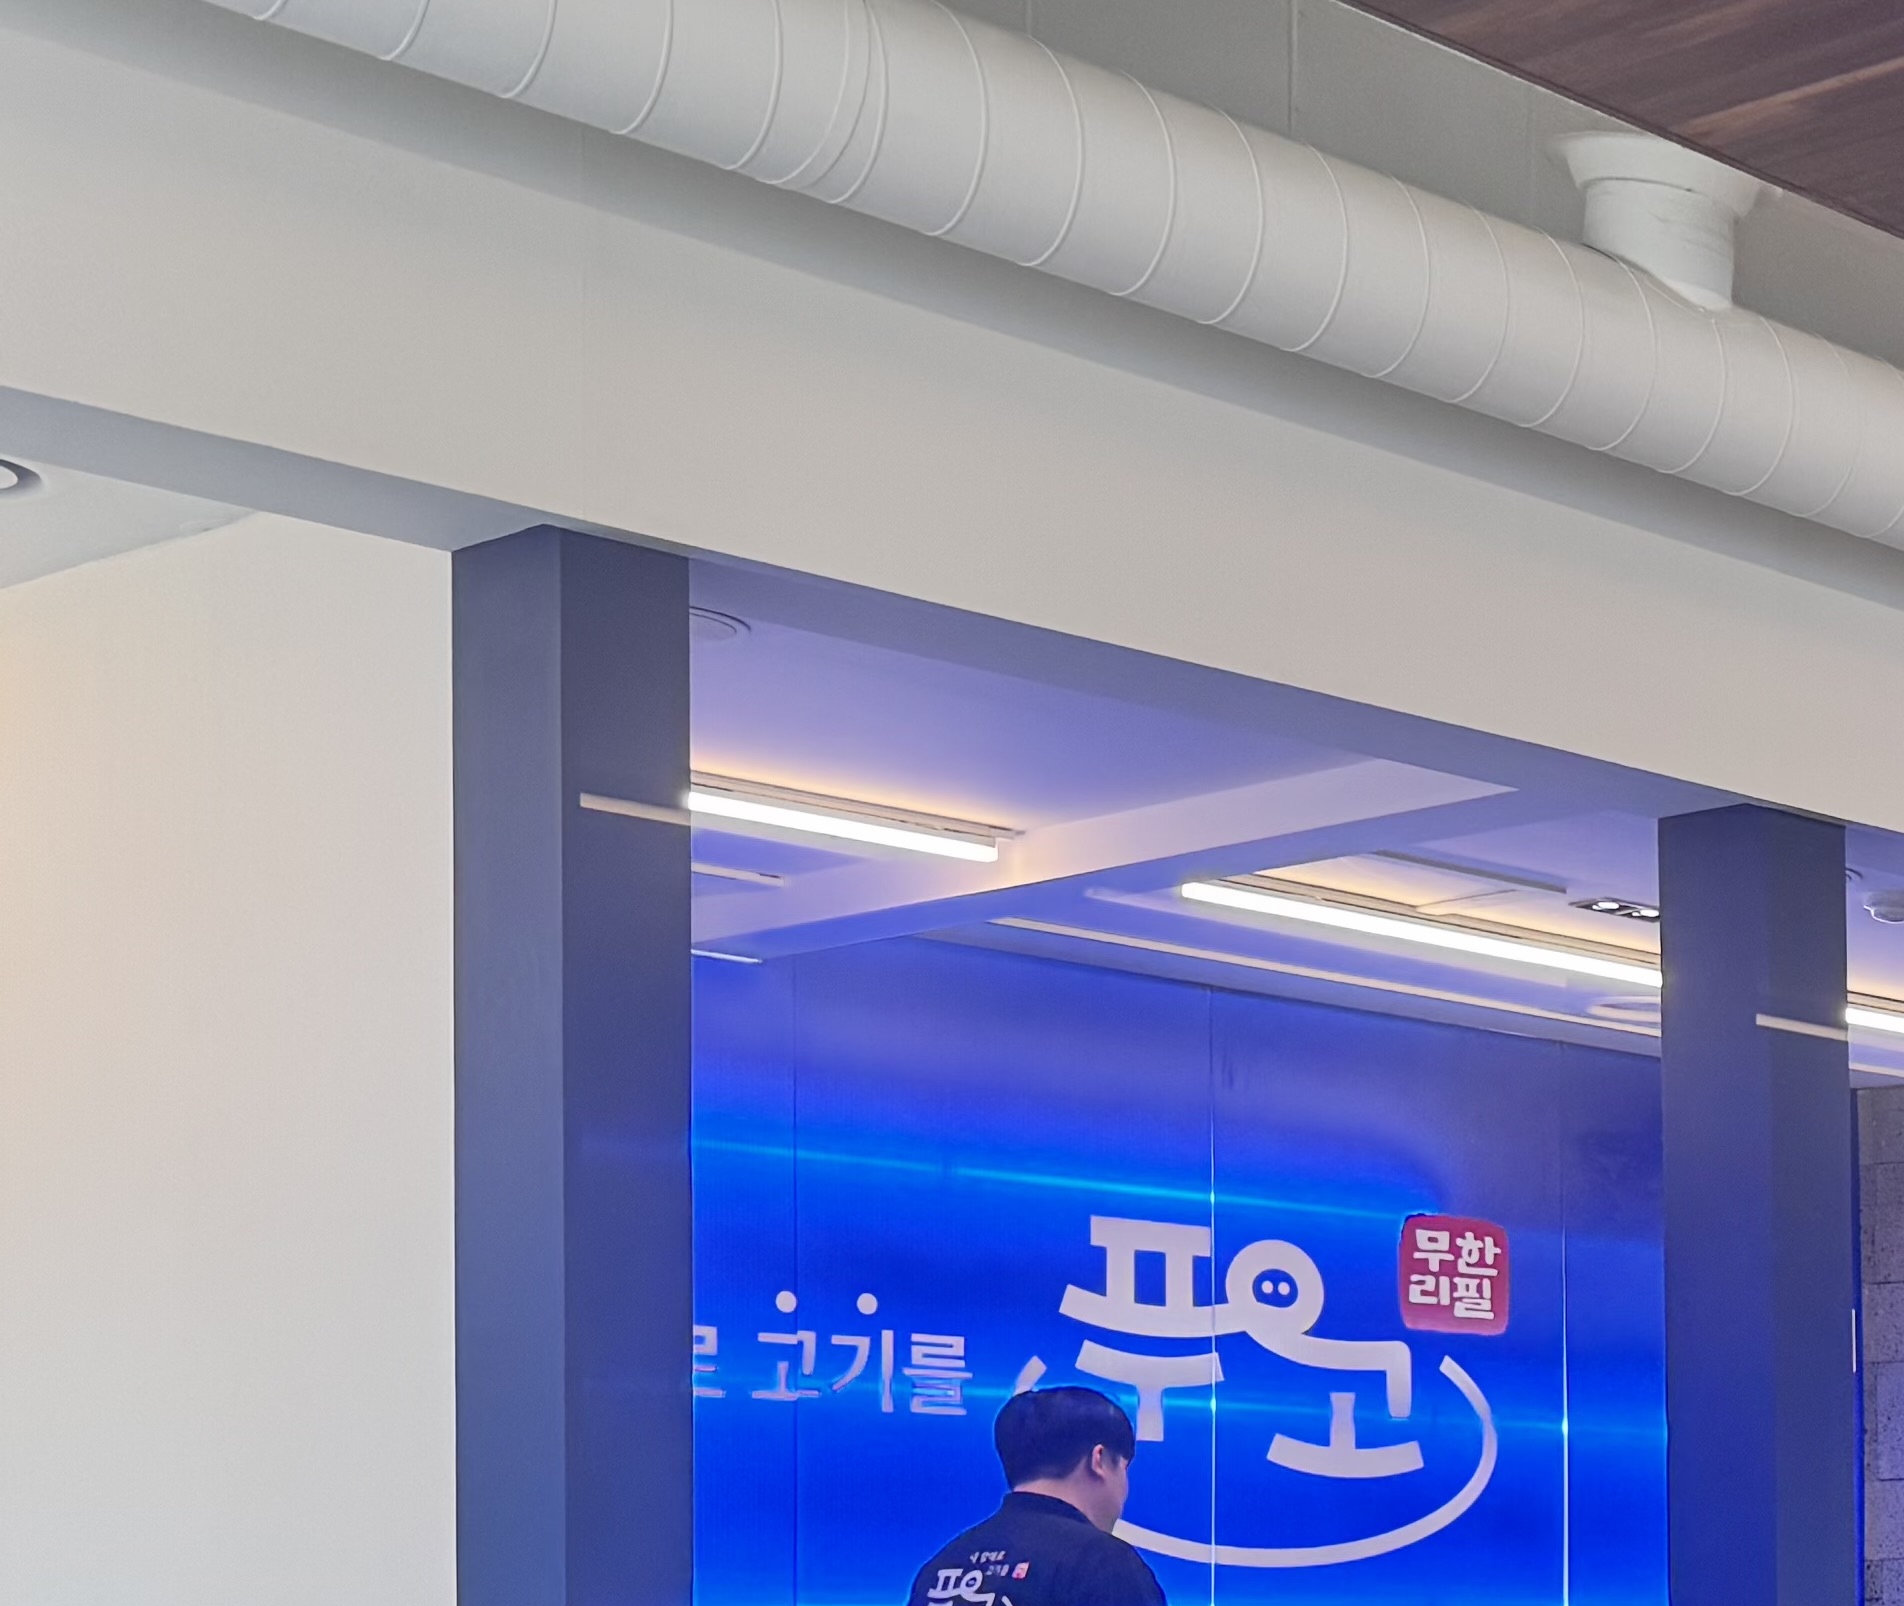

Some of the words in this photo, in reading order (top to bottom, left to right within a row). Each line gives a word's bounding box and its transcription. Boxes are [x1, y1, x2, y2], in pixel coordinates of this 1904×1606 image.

[1413, 1228, 1501, 1277] 무한
[1407, 1273, 1496, 1320] 리필
[751, 1291, 973, 1416] 고기를
